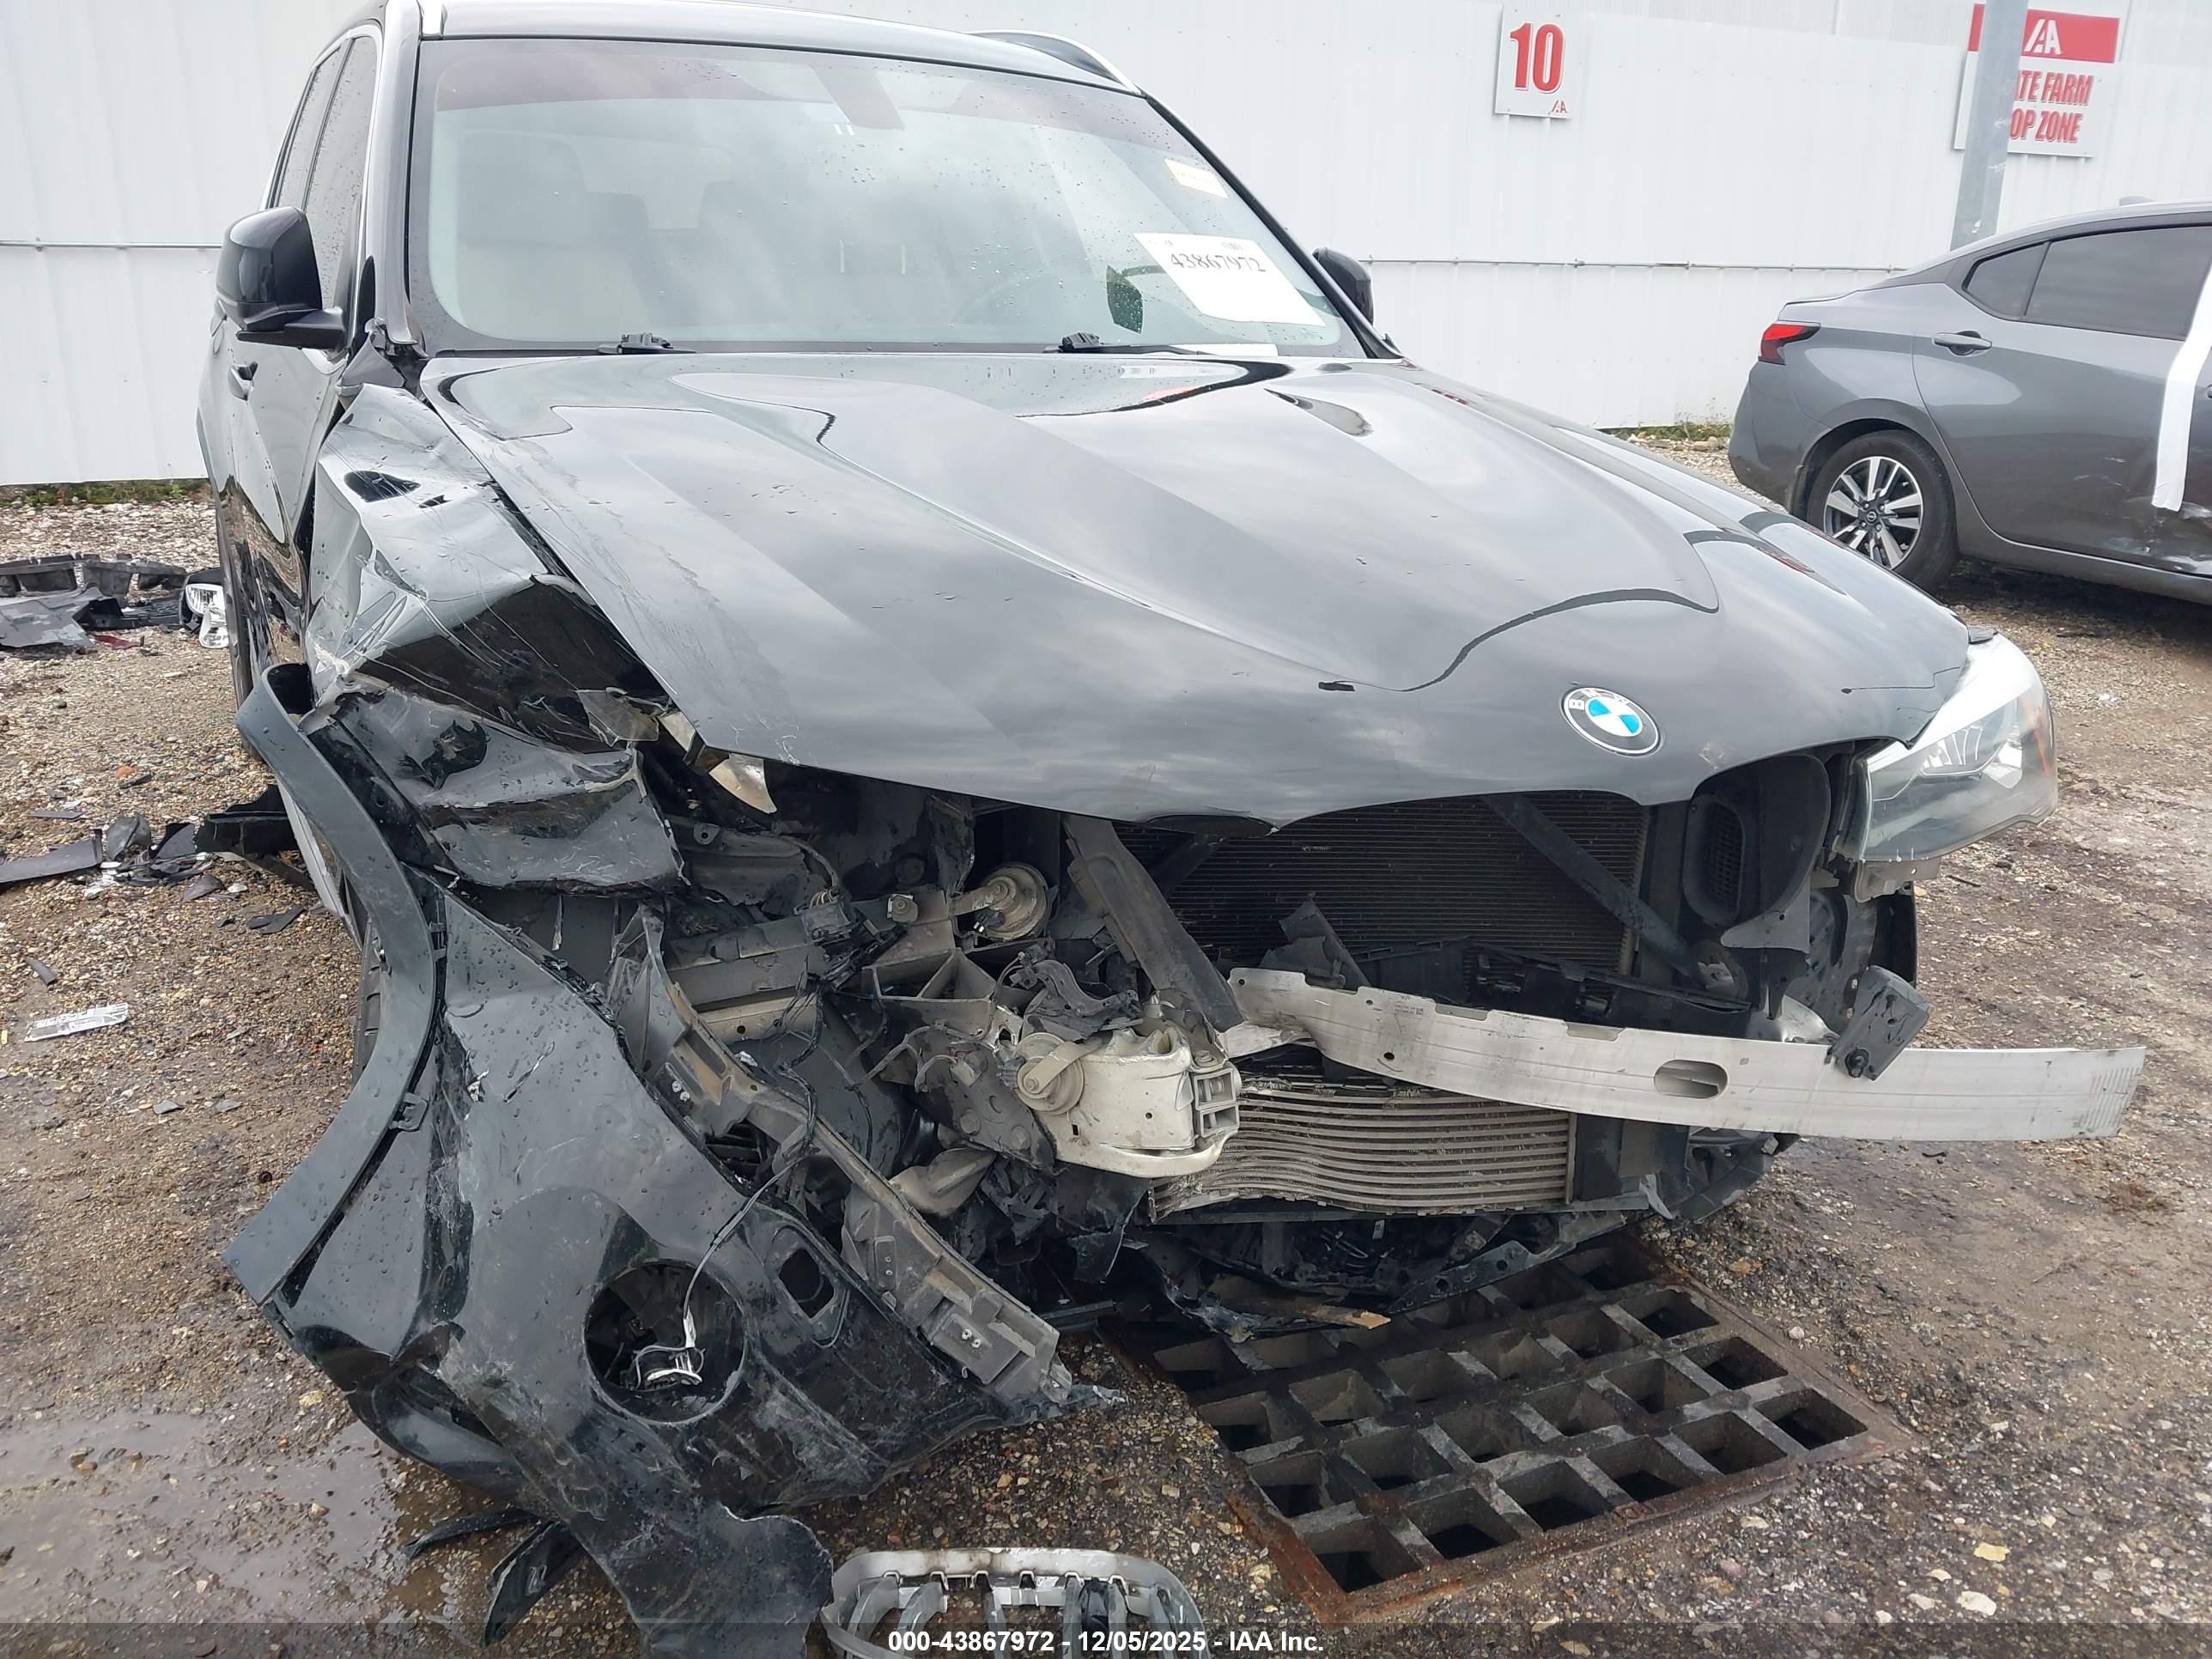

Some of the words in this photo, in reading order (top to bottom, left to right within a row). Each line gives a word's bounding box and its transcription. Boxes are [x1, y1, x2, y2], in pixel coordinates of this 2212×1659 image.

[1510, 22, 1565, 94] 10
[2040, 71, 2094, 106] FARM
[2009, 107, 2036, 139] OP
[2035, 110, 2083, 143] ZONE
[1170, 253, 1267, 272] 43867972
